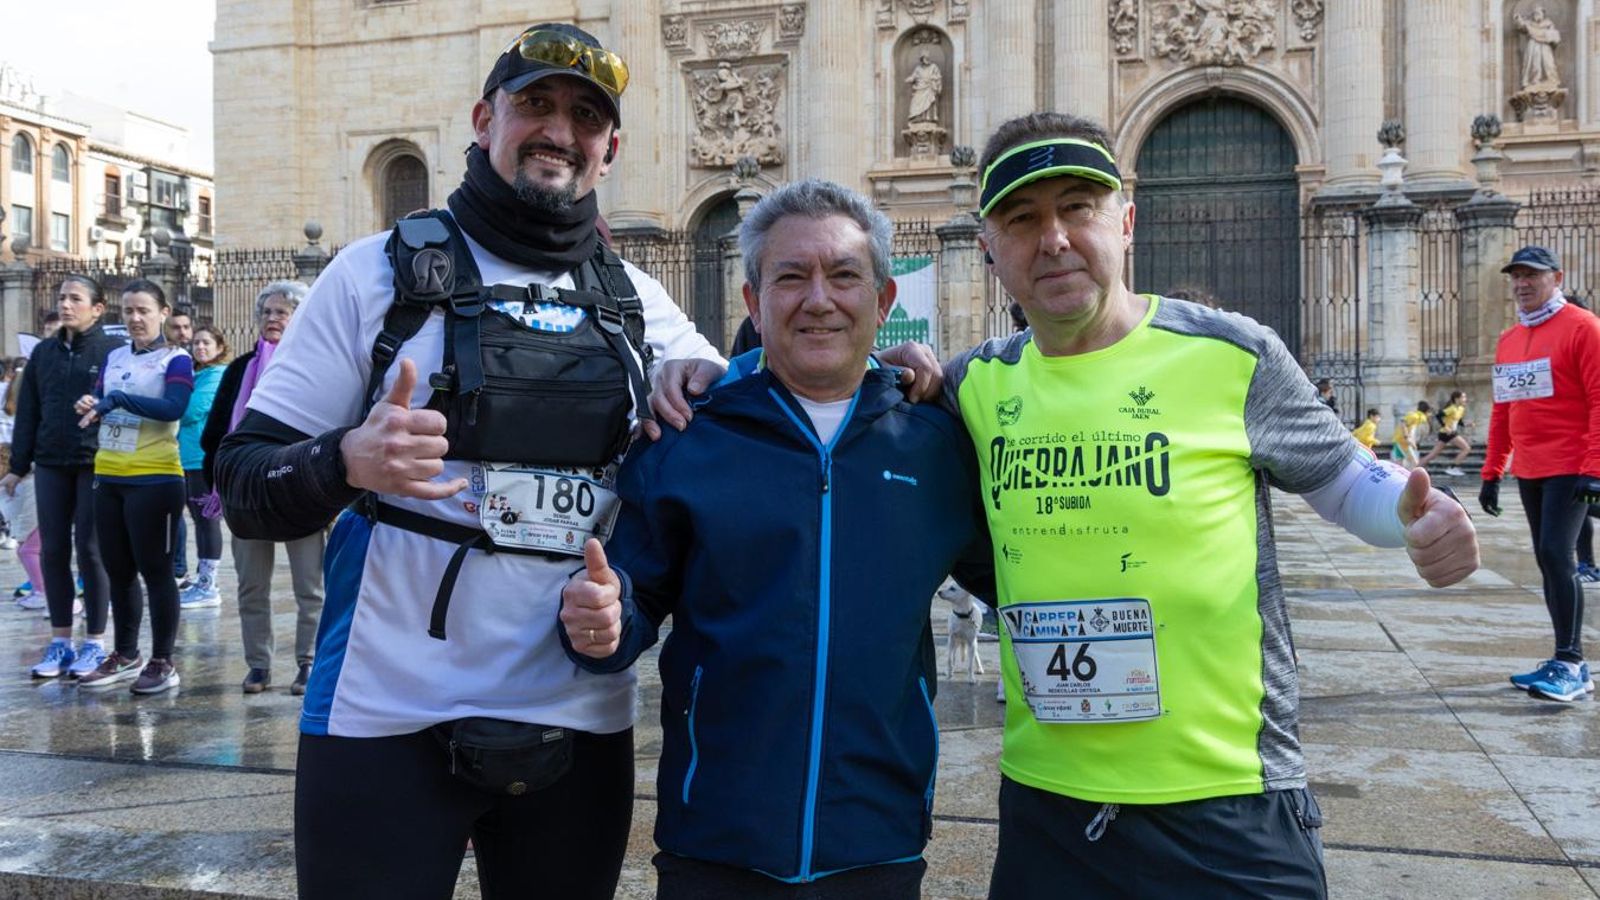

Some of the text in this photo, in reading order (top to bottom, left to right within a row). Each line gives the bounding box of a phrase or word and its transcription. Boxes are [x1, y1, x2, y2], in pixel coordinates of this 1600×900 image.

[1507, 371, 1537, 389] 252
[107, 425, 122, 439] 70
[1019, 431, 1067, 446] corrido
[1070, 430, 1086, 442] el
[1092, 430, 1142, 443] último
[989, 432, 1171, 511] QUIEBRAJANO
[533, 474, 595, 517] 180
[1059, 495, 1092, 510] SUBIDA
[1111, 608, 1148, 621] BUENA
[1023, 623, 1087, 638] CAMINATA
[1112, 620, 1149, 633] MUERTE
[1046, 642, 1097, 681] 46
